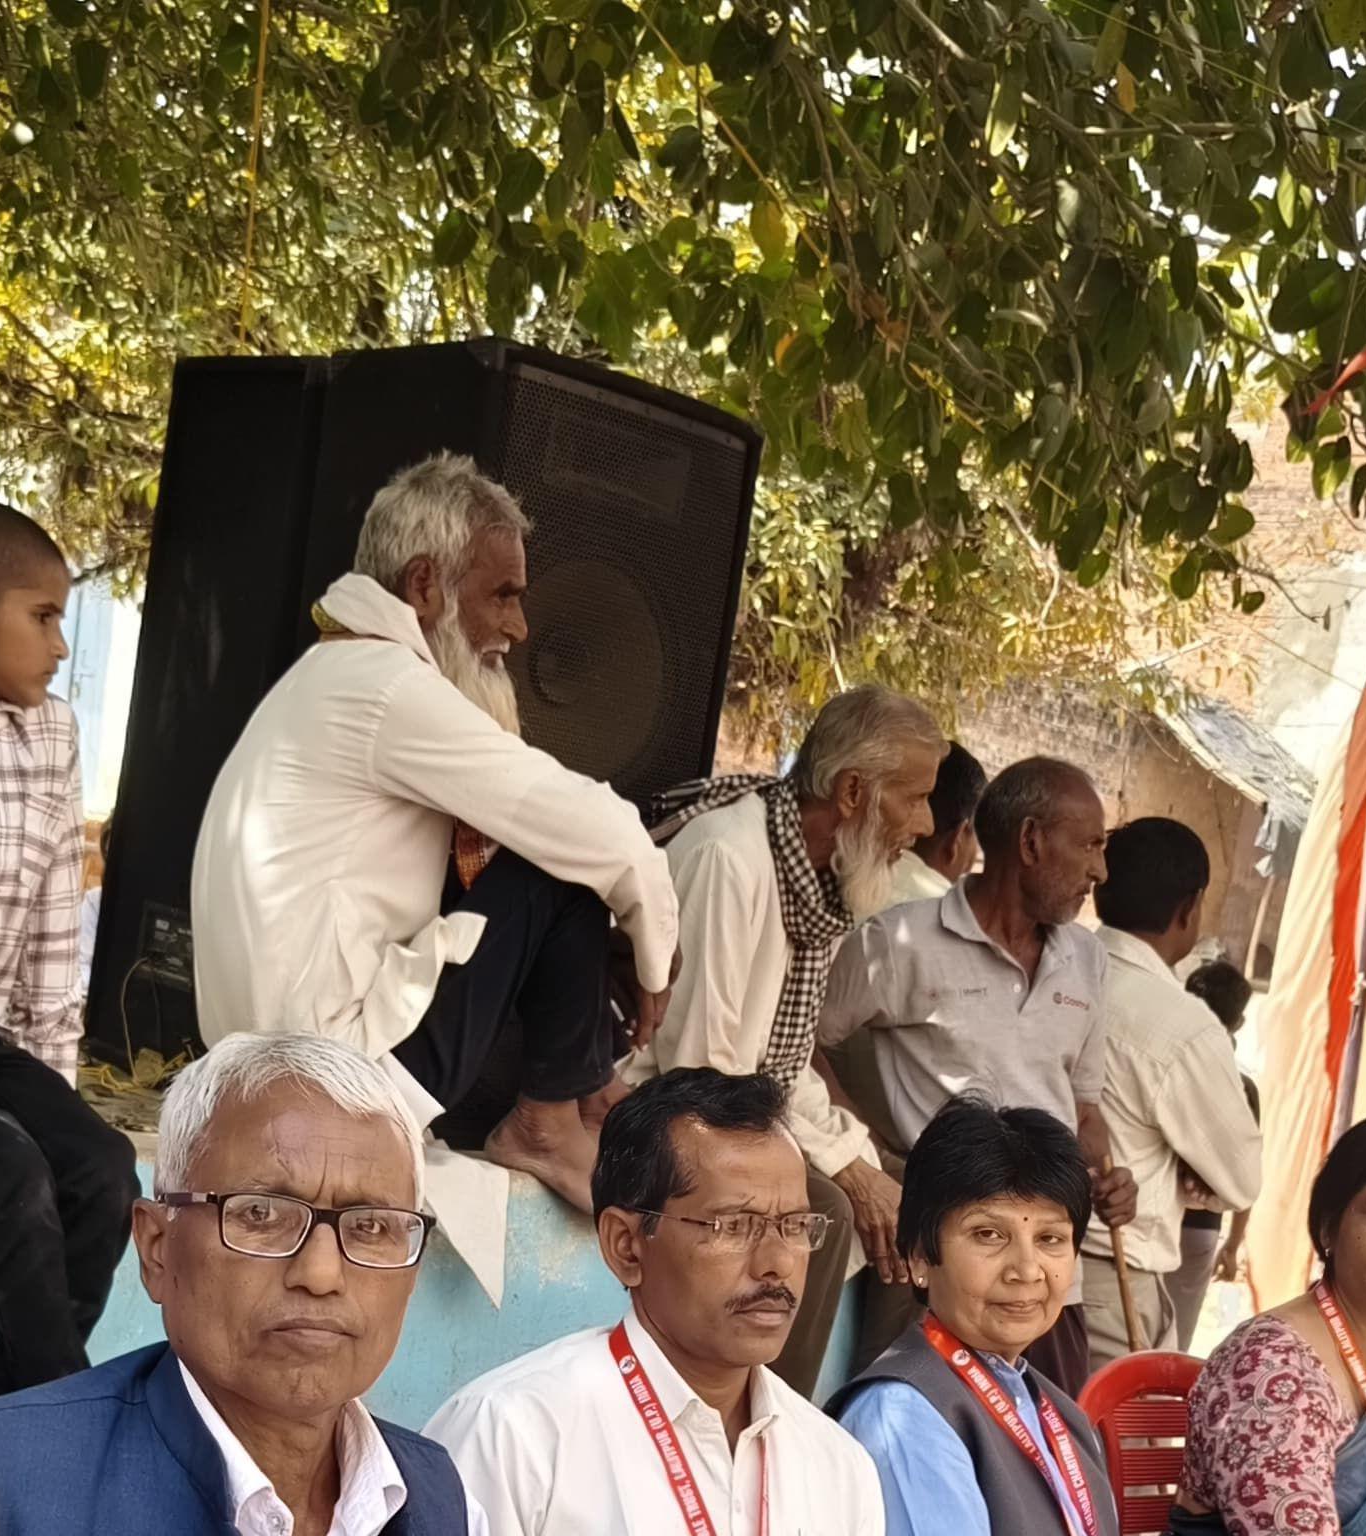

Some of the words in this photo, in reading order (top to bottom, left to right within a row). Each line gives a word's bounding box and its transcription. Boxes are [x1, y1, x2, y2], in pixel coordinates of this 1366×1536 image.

[627, 1373, 652, 1404] INDIA
[965, 1363, 992, 1393] INDIA
[1000, 1409, 1039, 1454] LALITPUR
[652, 1428, 688, 1482] LALITPUR
[1051, 1431, 1086, 1488] CHARITABLE
[674, 1478, 704, 1518] TRUST,
